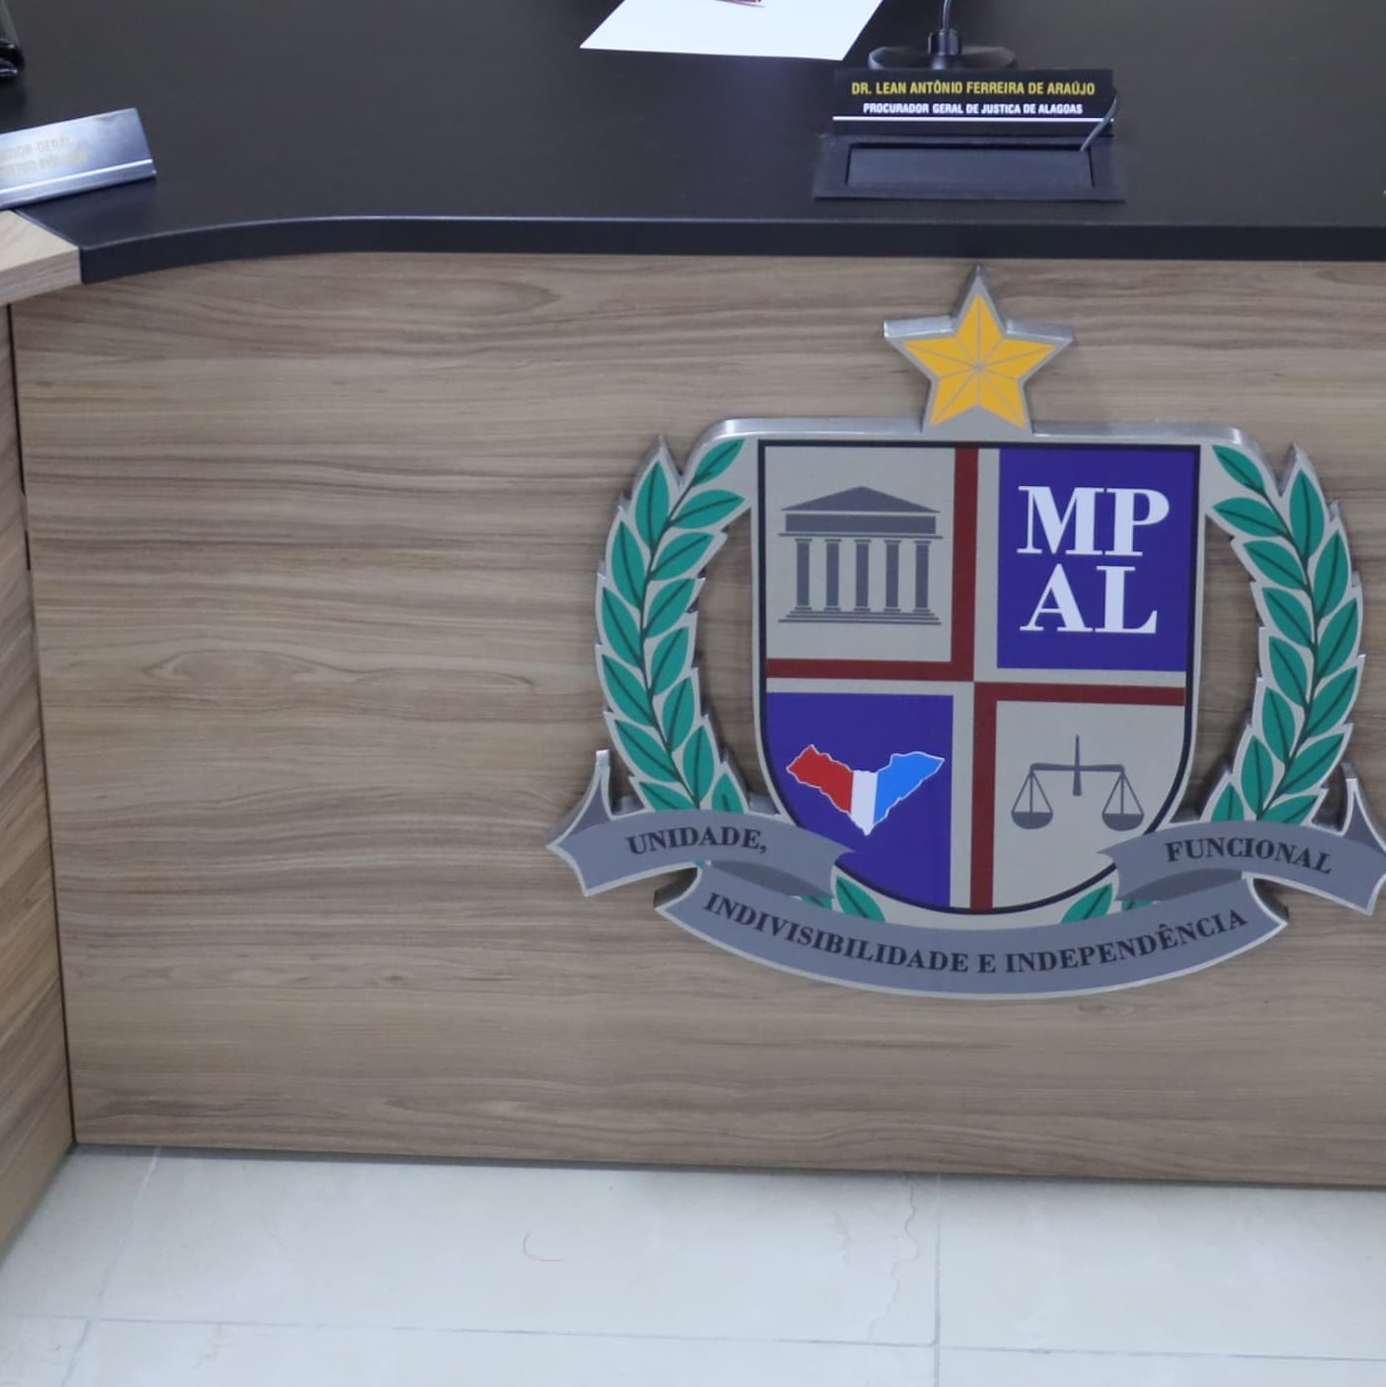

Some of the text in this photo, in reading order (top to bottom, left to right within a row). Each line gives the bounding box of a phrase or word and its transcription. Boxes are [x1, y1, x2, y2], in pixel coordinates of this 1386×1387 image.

[852, 79, 1096, 96] DR. LEAN ANTÔNIO FERREIRA DE ARAÚJO
[863, 102, 930, 114] PROCURADOR
[933, 102, 964, 114] GERAL
[966, 103, 979, 114] DE
[1023, 103, 1036, 114] DE
[1038, 103, 1083, 114] ALAGOAS
[1016, 485, 1170, 557] MP
[1019, 563, 1158, 634] AL
[626, 824, 769, 856] UNIDADE,
[1164, 836, 1333, 876] FUNCIONAL
[703, 891, 1250, 974] INDIVISIBILIDADE E INDEPENDÊNCIA
